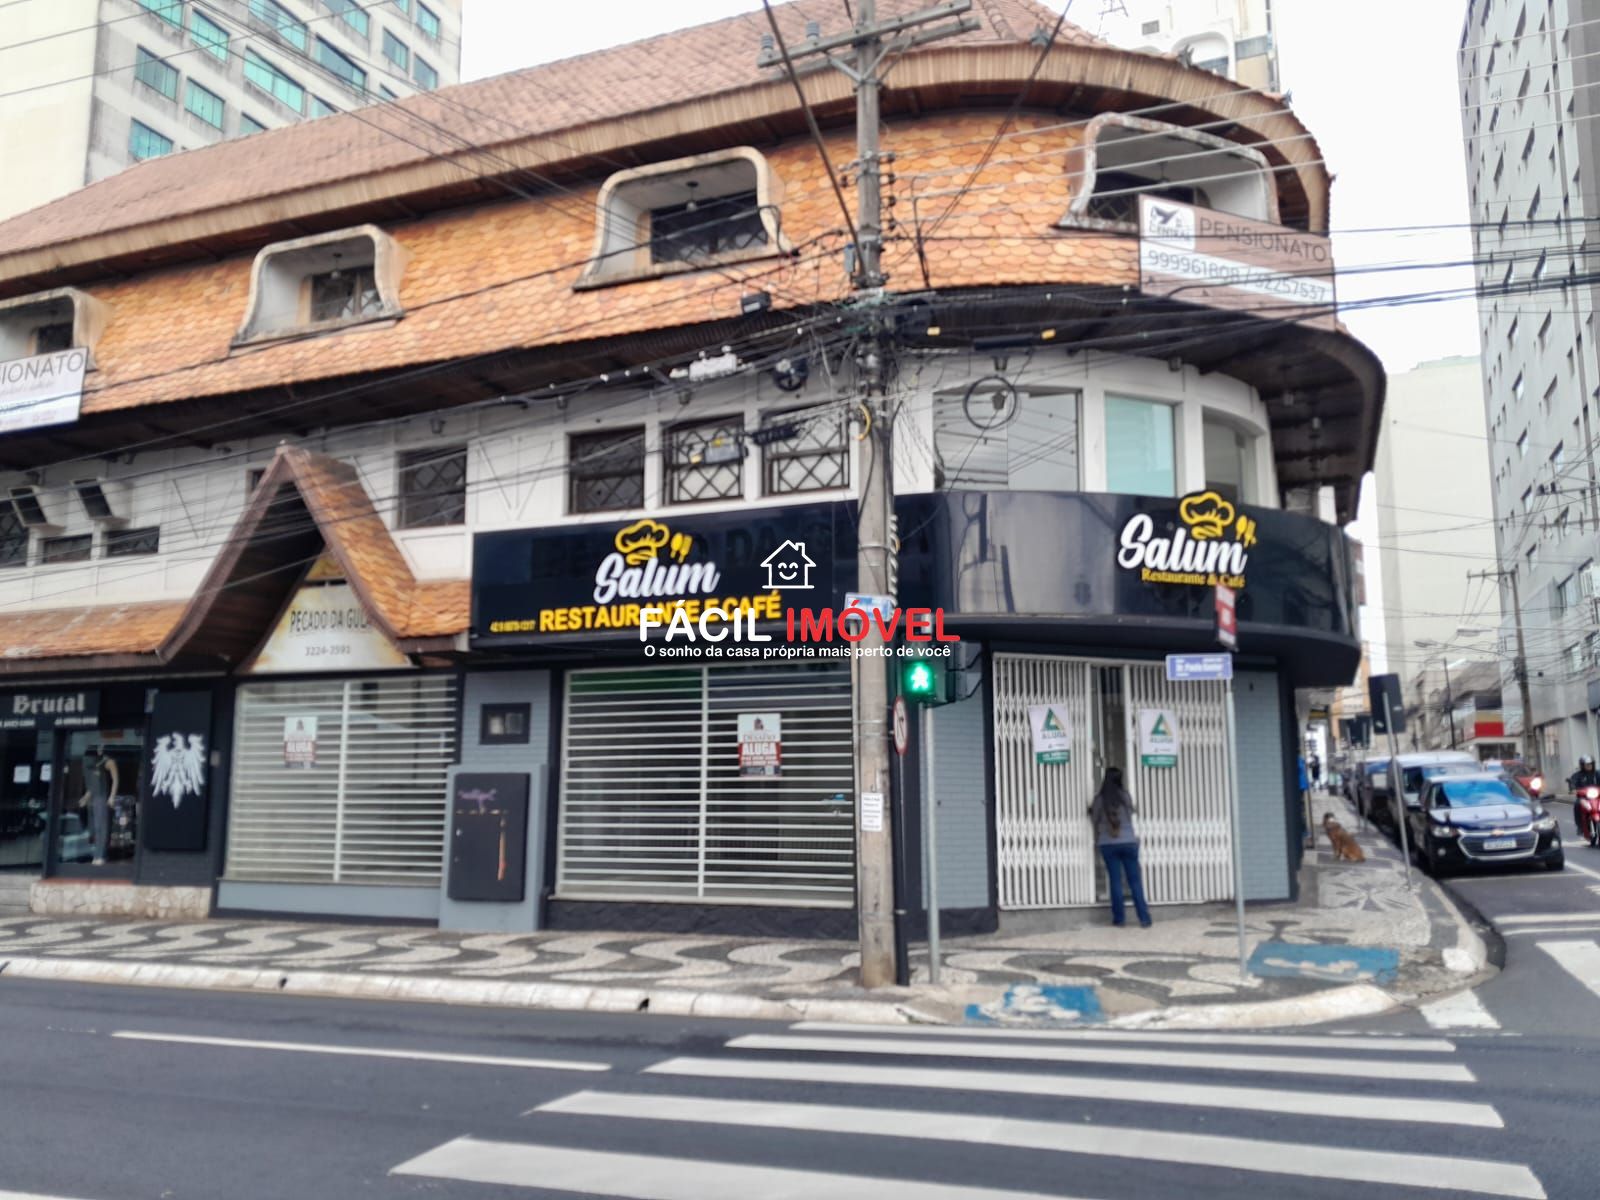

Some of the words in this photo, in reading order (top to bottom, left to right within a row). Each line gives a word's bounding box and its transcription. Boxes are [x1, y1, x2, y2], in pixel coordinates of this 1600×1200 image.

[1200, 217, 1327, 262] PENSIONATO
[0, 352, 84, 385] IONATO
[1117, 513, 1248, 576] Salum
[594, 552, 721, 604] Salum
[290, 609, 328, 632] PECADO
[331, 609, 343, 629] DA
[13, 693, 85, 715] Brutal
[742, 742, 777, 755] ALUGA
